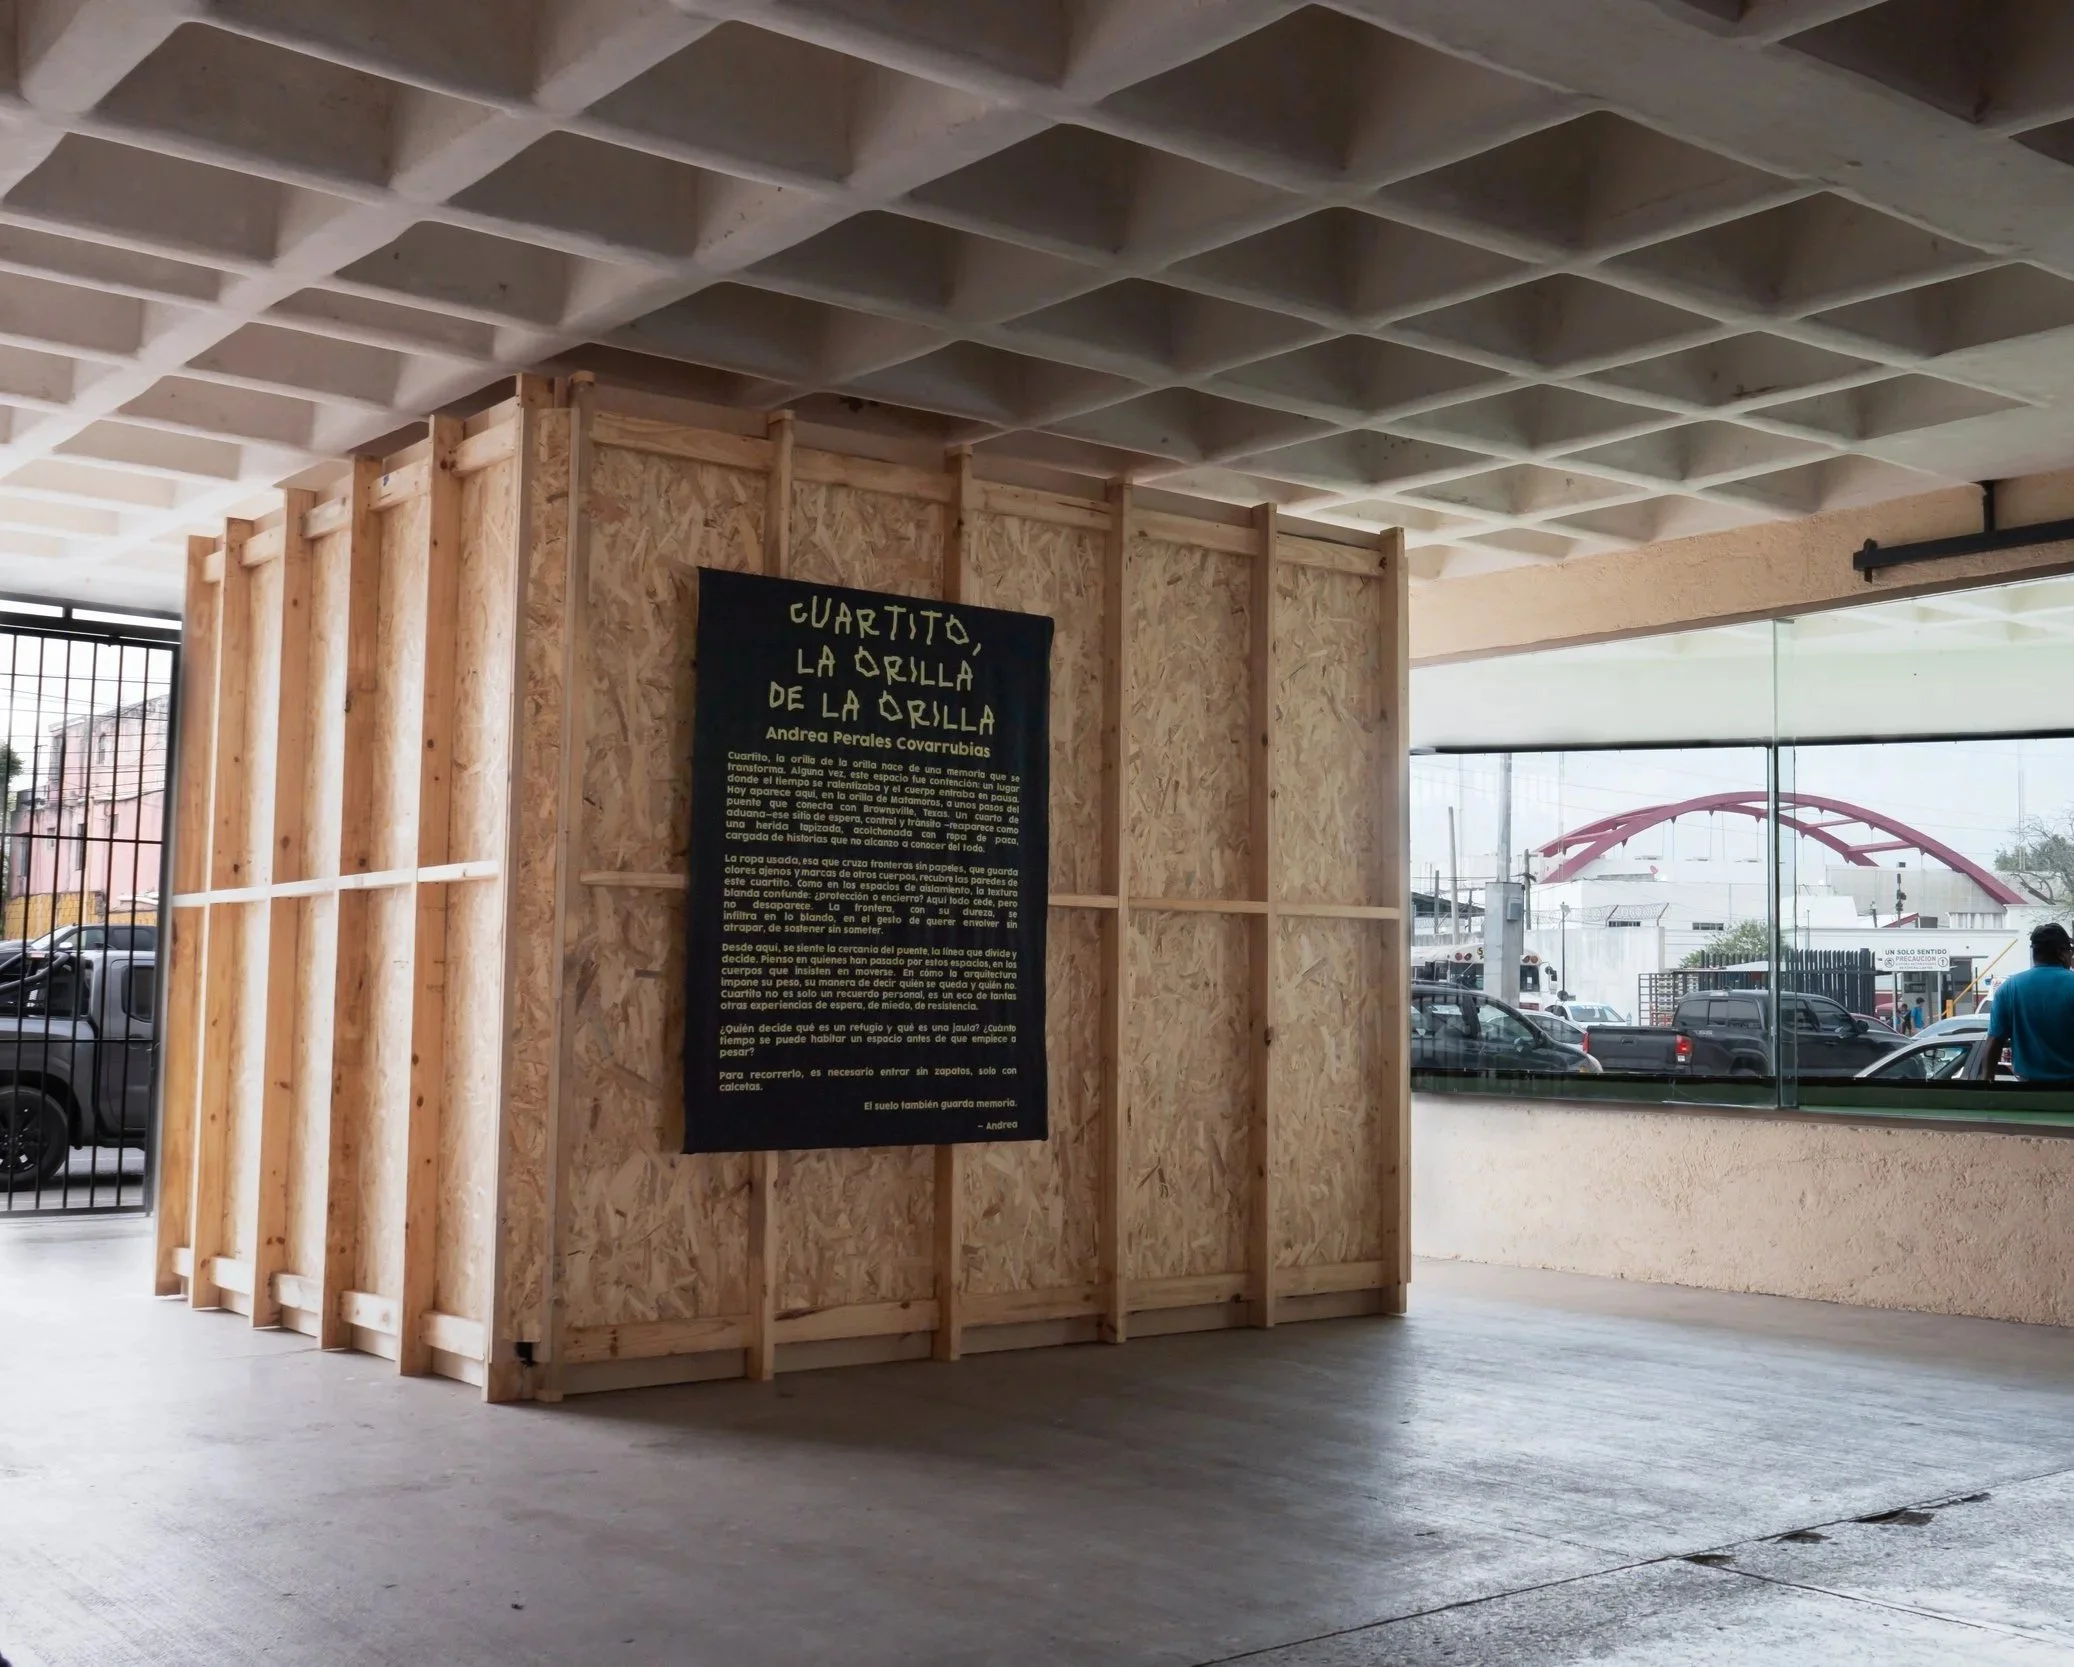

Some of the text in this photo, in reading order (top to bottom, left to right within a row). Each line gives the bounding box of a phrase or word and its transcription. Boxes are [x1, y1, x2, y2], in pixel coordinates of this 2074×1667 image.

[790, 595, 982, 656] CUARTITO,
[797, 645, 974, 691] LA ORILLA
[768, 682, 995, 736] DE LA ORILLA
[766, 726, 991, 758] Andrea Perales Covarrubias
[727, 750, 770, 762] Cuartito,
[775, 753, 785, 762] la
[790, 755, 815, 764] orilla
[820, 757, 833, 766] de
[838, 758, 847, 767] la
[852, 760, 876, 769] orilla
[881, 763, 903, 771] nace
[908, 764, 920, 772] de
[946, 769, 985, 778] memoria
[989, 773, 1006, 781] que
[727, 762, 786, 774] transforma.
[790, 766, 823, 777] Alguna
[828, 770, 846, 779] vez,
[850, 771, 869, 780] este
[873, 774, 908, 783] espacio
[911, 775, 926, 784] fue
[929, 778, 980, 789] contención:
[996, 782, 1020, 793] lugar
[727, 774, 759, 783] donde
[763, 776, 772, 784] el
[775, 776, 809, 788] tiempo
[827, 780, 880, 791] ralentizaba
[883, 785, 889, 793] y
[892, 784, 900, 792] el
[904, 786, 935, 796] cuerpo
[938, 788, 975, 798] entraba
[990, 794, 1019, 803] pausa.
[726, 798, 761, 807] puente
[769, 800, 787, 809] que
[795, 801, 833, 810] conecta
[863, 804, 916, 817] Brownsville,
[922, 808, 949, 818] Texas.
[955, 810, 967, 819] Un
[974, 813, 1002, 822] cuarto
[1008, 815, 1019, 824] de
[725, 831, 768, 841] cargada
[770, 832, 783, 841] de
[786, 833, 827, 843] historias
[830, 836, 848, 845] que
[863, 837, 899, 847] alcanzo
[910, 841, 946, 850] conocer
[947, 842, 960, 851] del
[962, 843, 984, 853] todo.
[755, 821, 788, 830] herida
[799, 822, 843, 834] tapizada,
[853, 826, 912, 837] acolchonada
[946, 833, 966, 842] ropa
[976, 833, 986, 842] de
[994, 837, 1018, 846] paca,
[724, 853, 737, 862] La
[739, 856, 764, 865] ropa
[766, 855, 801, 866] usada,
[821, 859, 839, 867] que
[870, 859, 913, 869] fronteras
[915, 861, 927, 870] sin
[928, 863, 966, 874] papeles,
[968, 866, 985, 875] que
[986, 867, 1018, 876] guarda
[724, 877, 745, 886] este
[750, 878, 792, 887] cuartito.
[797, 879, 822, 888] Como
[842, 880, 856, 889] los
[859, 882, 899, 892] espacios
[904, 883, 916, 892] de
[919, 884, 972, 896] aislamiento,
[976, 886, 984, 895] la
[987, 887, 1017, 897] textura
[723, 923, 883, 934] atrapar, de sostener sin someter.
[721, 954, 758, 963] decide.
[760, 954, 793, 963] Pienso
[810, 955, 847, 965] quienes
[849, 956, 867, 964] han
[869, 956, 904, 966] pasado
[907, 959, 923, 967] por
[924, 958, 948, 966] estos
[950, 959, 990, 969] espacios,
[1005, 960, 1016, 968] los
[720, 989, 761, 998] Cuartito
[796, 989, 817, 998] solo
[836, 990, 879, 998] recuerdo
[882, 990, 924, 1000] personal,
[976, 991, 987, 1000] de
[990, 991, 1016, 1000] tantas
[720, 1000, 978, 1011] otras experiencias de espera, de miedo, de resistencia.
[719, 1035, 755, 1045] tiempo
[775, 1034, 806, 1045] puede
[810, 1034, 846, 1043] habitar
[866, 1034, 902, 1044] espacio
[906, 1034, 930, 1043] antes
[934, 1034, 946, 1043] de
[950, 1036, 967, 1045] que
[971, 1034, 1007, 1045] empiece
[719, 1046, 754, 1058] pesar?
[719, 1082, 763, 1090] calcetas.
[864, 1099, 1017, 1110] El suelo también guarda memoria.
[985, 1121, 1017, 1130] Andrea
